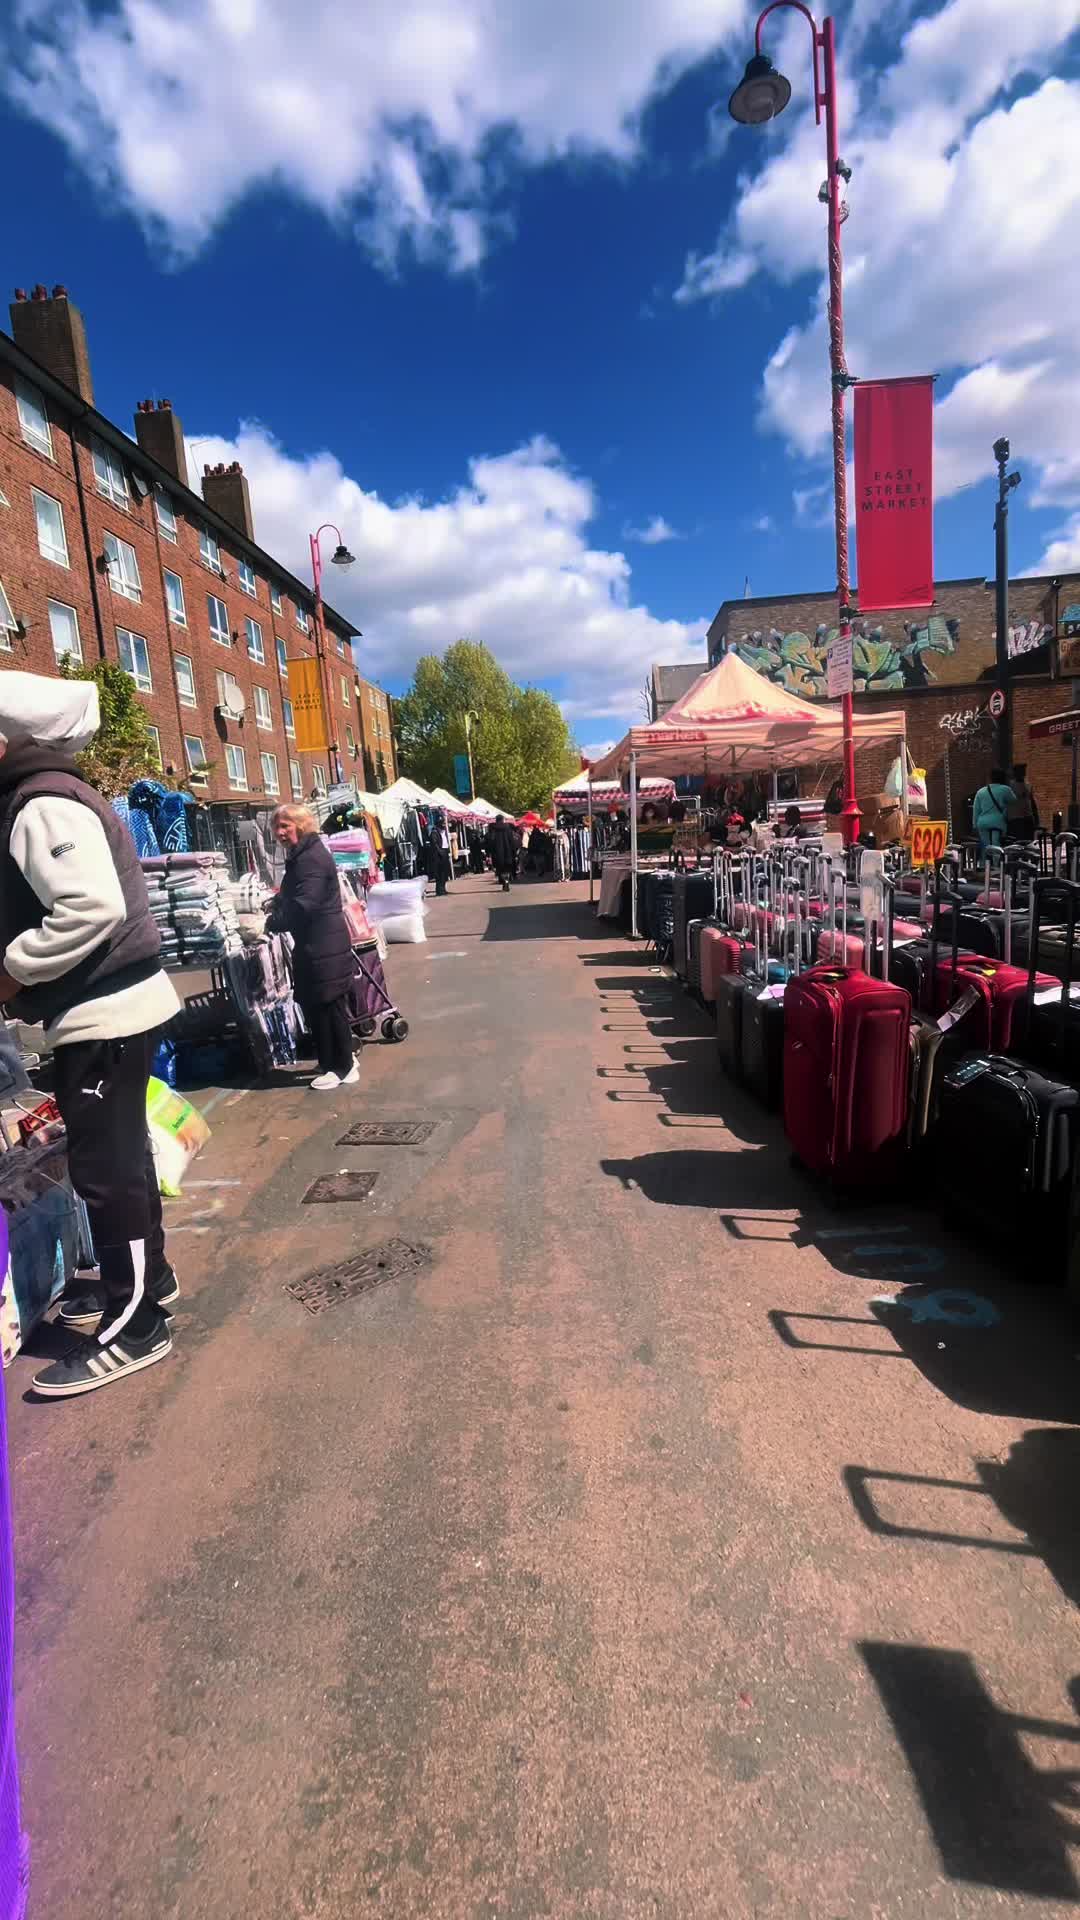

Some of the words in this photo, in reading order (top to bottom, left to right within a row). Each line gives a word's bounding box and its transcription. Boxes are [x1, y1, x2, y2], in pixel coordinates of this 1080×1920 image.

[874, 469, 913, 480] EAST
[863, 482, 923, 497] STREET
[862, 497, 927, 512] MARKET
[914, 828, 943, 859] £20
